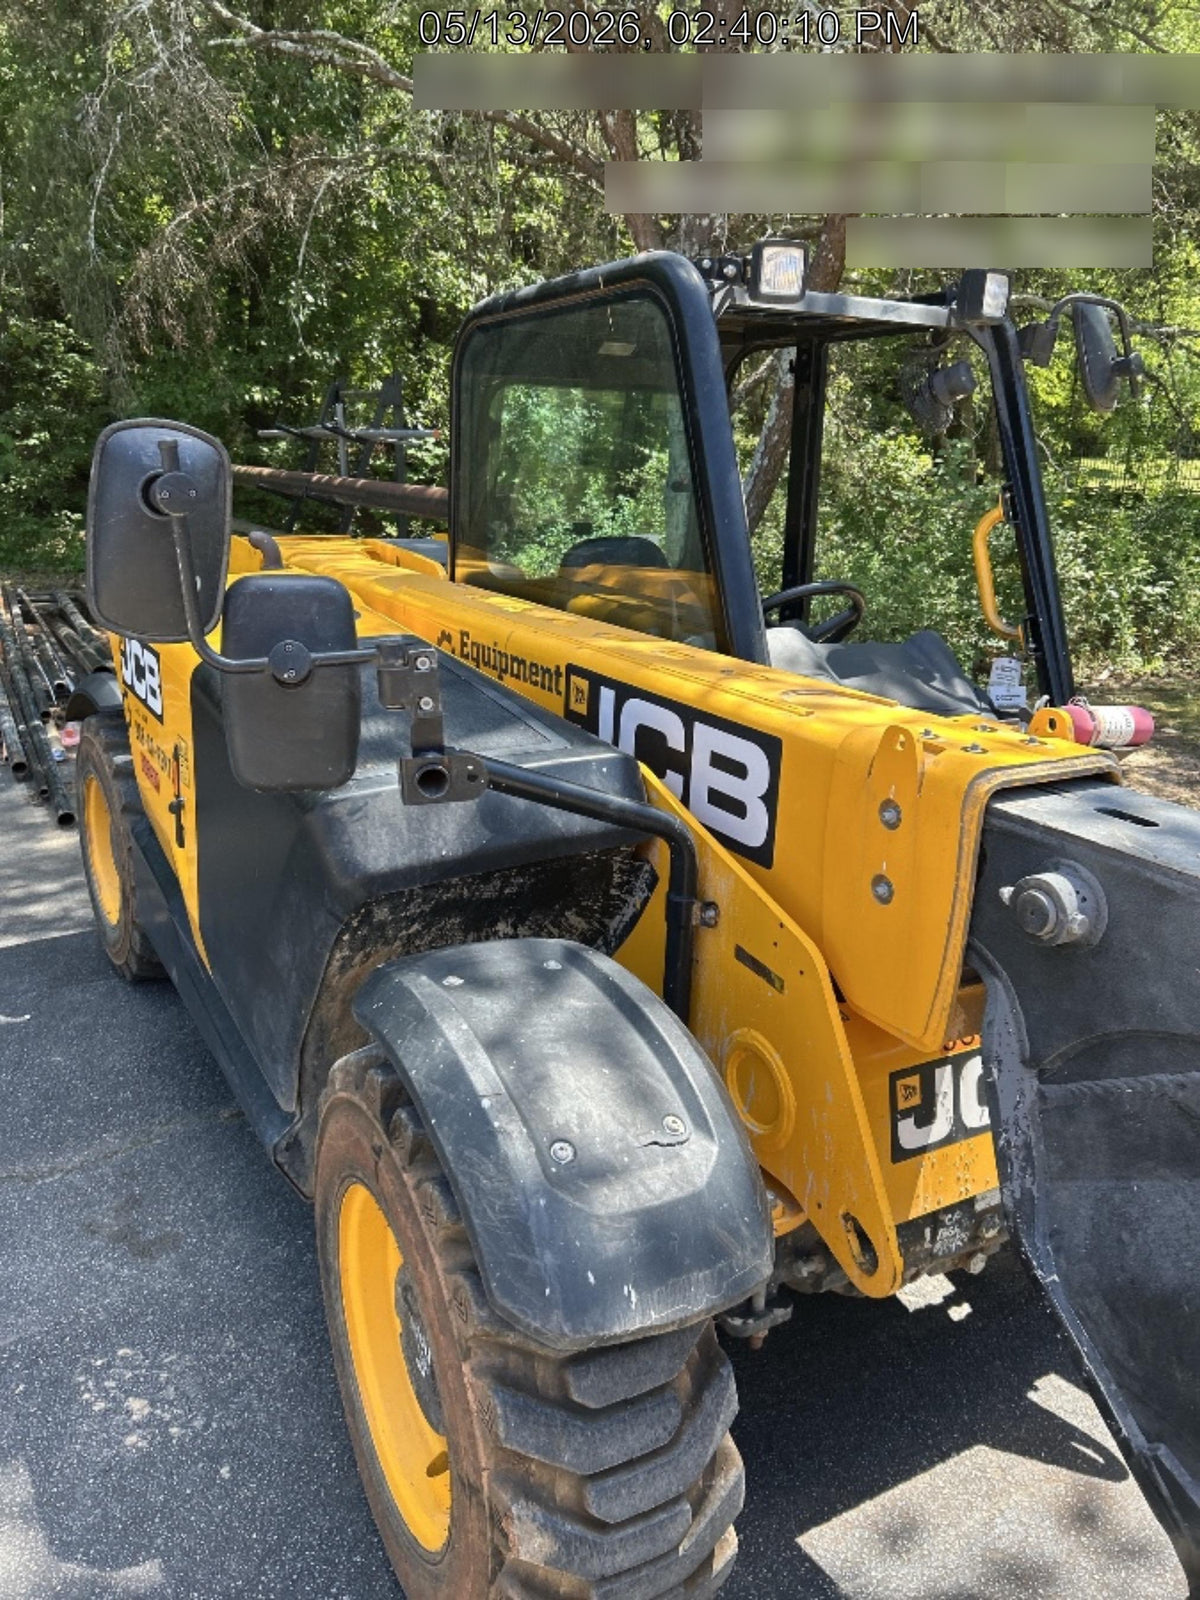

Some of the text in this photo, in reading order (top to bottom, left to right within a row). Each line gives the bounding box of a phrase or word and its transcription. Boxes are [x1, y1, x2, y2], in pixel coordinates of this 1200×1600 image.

[121, 638, 163, 716] JCB
[459, 629, 563, 696] Equipment
[897, 1055, 991, 1150] JC
